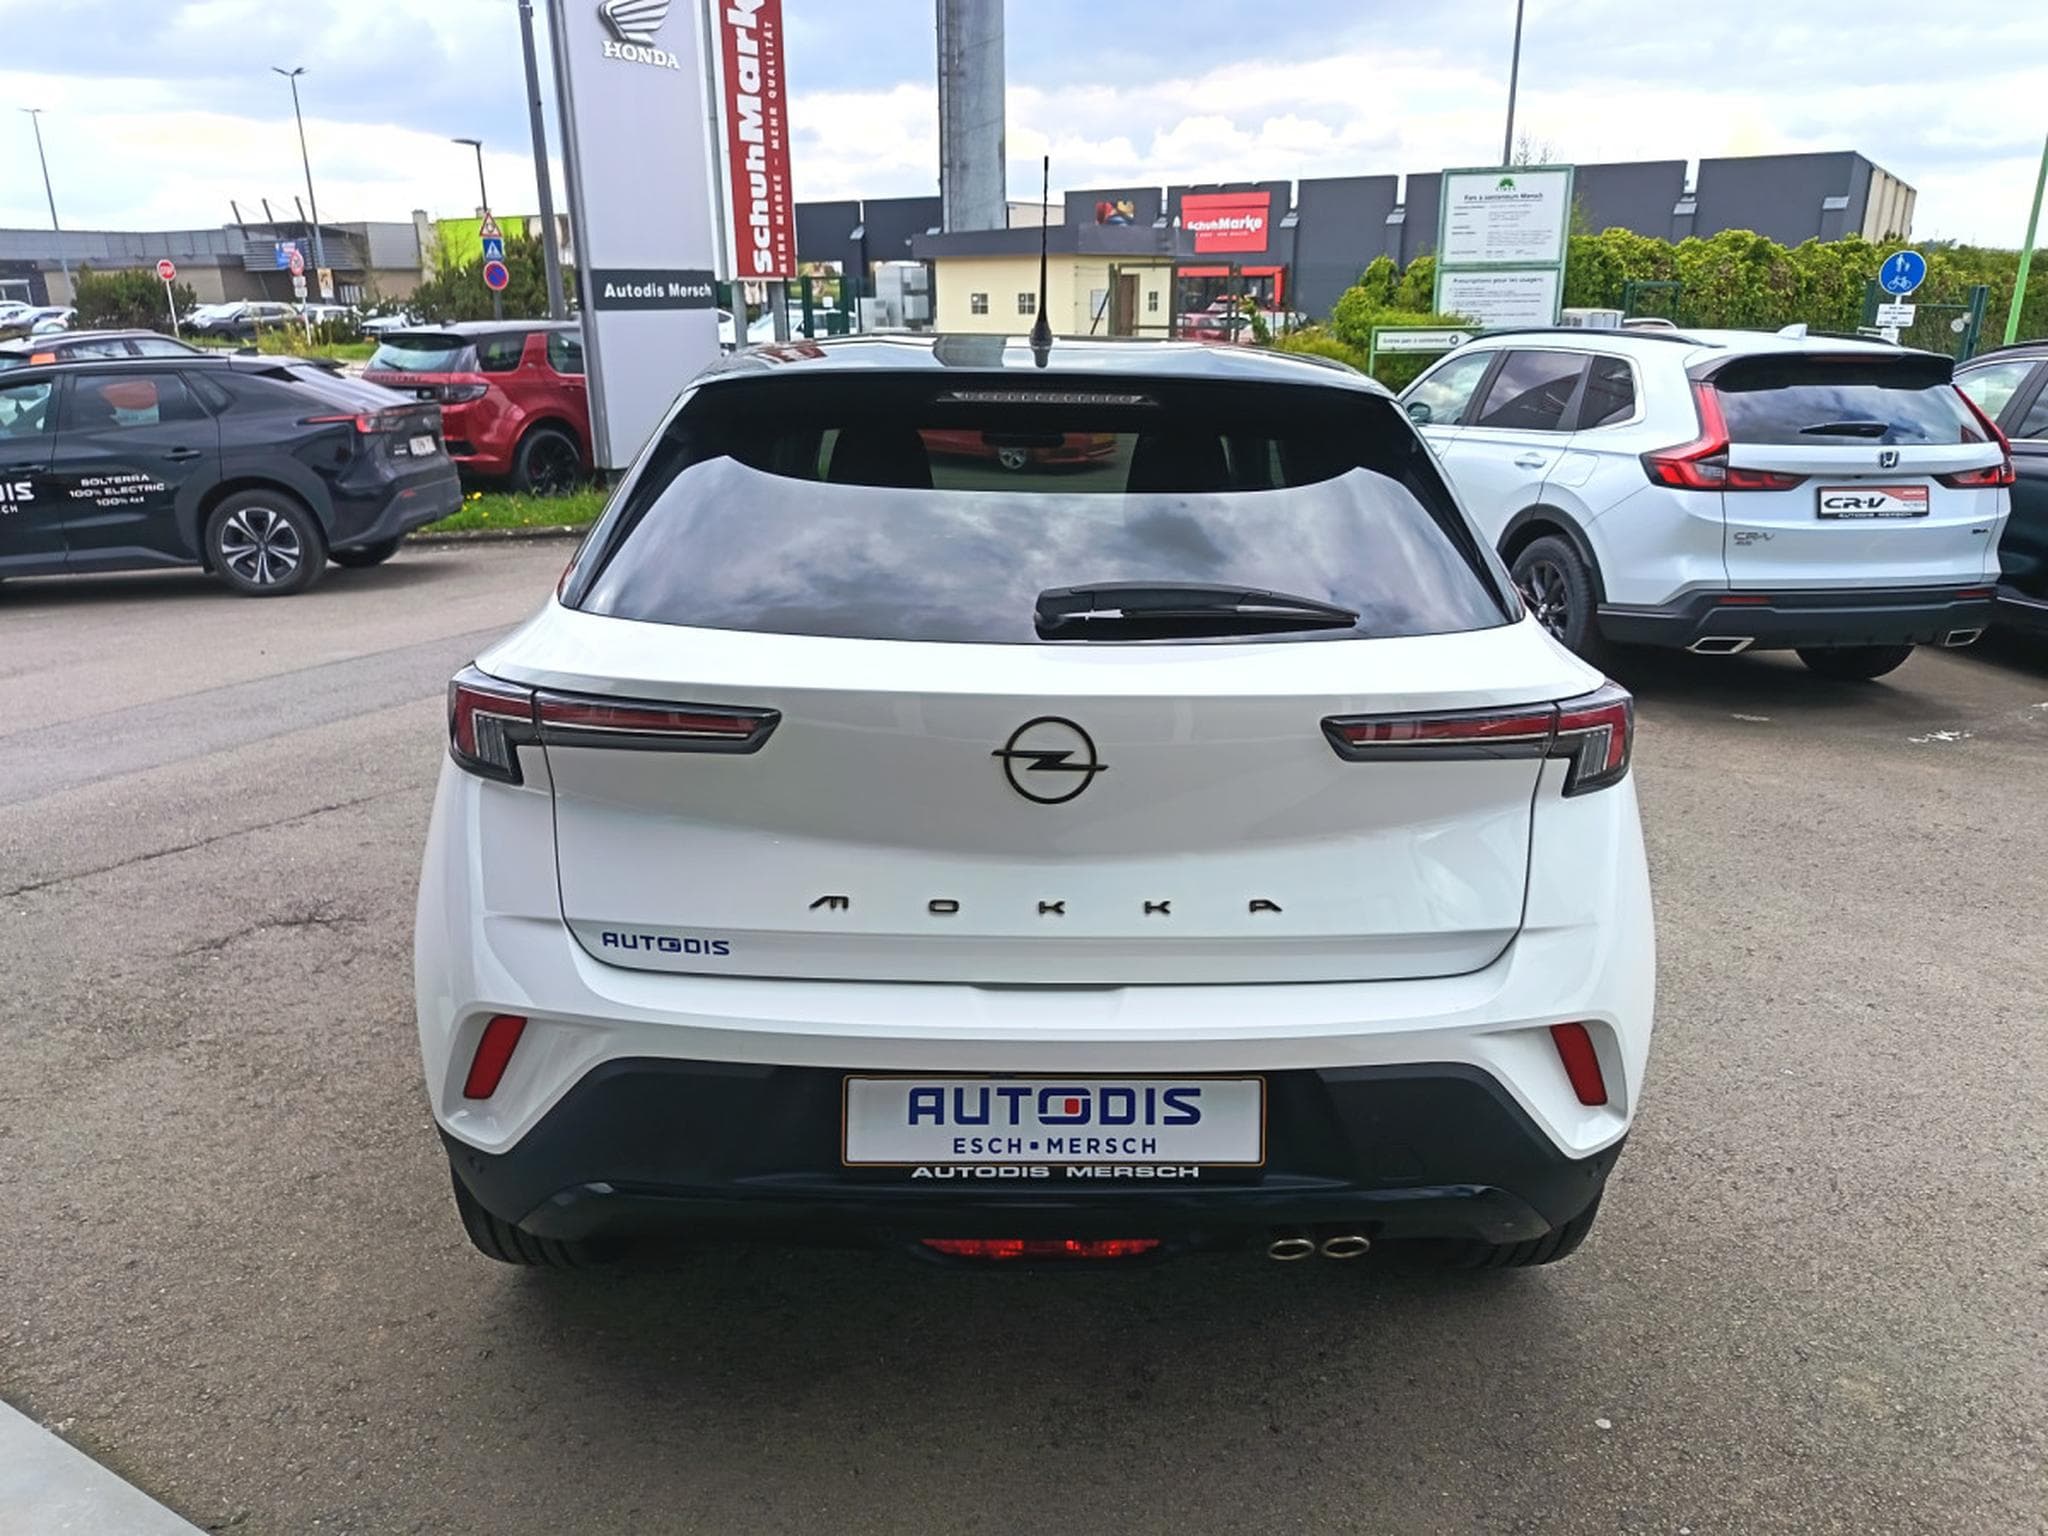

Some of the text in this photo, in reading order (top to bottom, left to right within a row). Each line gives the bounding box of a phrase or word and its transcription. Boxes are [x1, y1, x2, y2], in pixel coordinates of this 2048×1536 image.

[602, 40, 681, 70] HONDA
[768, 106, 780, 151] MEHR
[772, 174, 785, 226] MARKE
[604, 282, 713, 298] Autodis Mersch
[81, 473, 150, 487] SOLTERRA
[69, 483, 165, 498] 100% ELECTRIC
[809, 895, 1282, 914] MOKKA
[602, 931, 730, 956] AUTODIS
[907, 1086, 1202, 1126] AUTODIS
[953, 1137, 1157, 1154] ESCH MERSCH
[911, 1166, 1200, 1179] AUTODIS MERSCH
